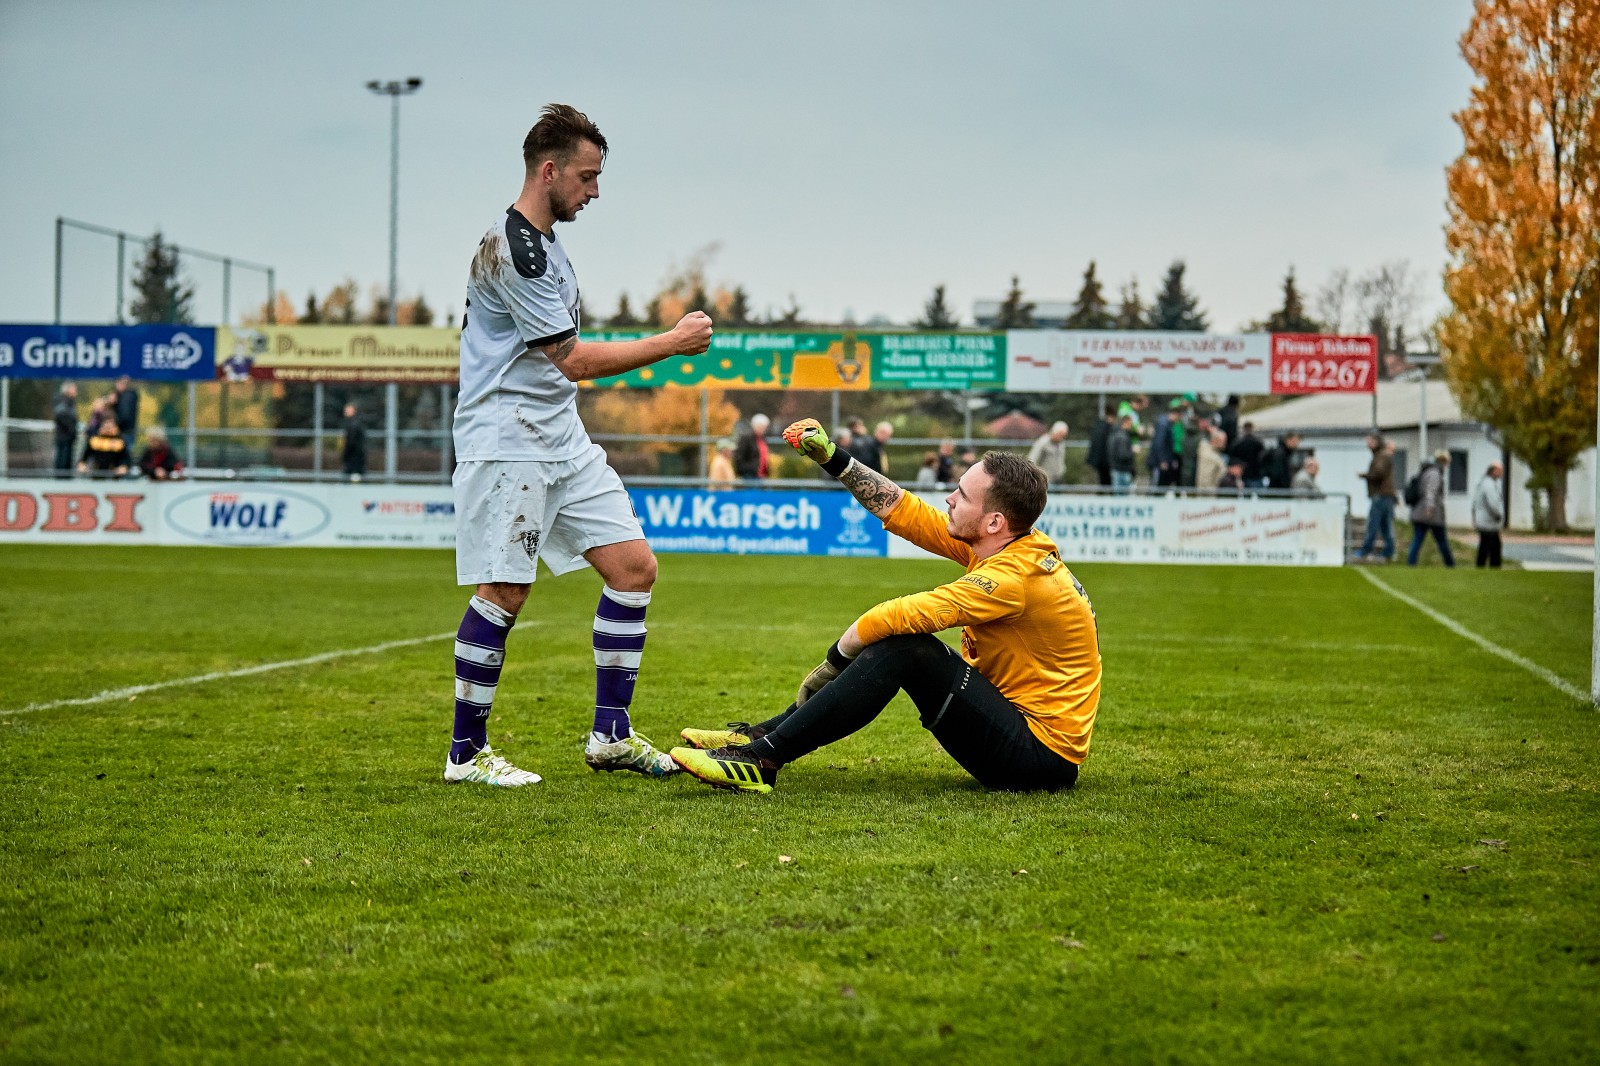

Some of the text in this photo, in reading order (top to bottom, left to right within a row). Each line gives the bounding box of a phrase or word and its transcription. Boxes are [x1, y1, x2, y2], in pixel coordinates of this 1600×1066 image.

[22, 336, 121, 368] GmbH
[954, 336, 995, 350] PIRNA
[1274, 359, 1371, 388] 442267
[209, 499, 287, 528] WOLF
[960, 666, 971, 690] KIPSTA
